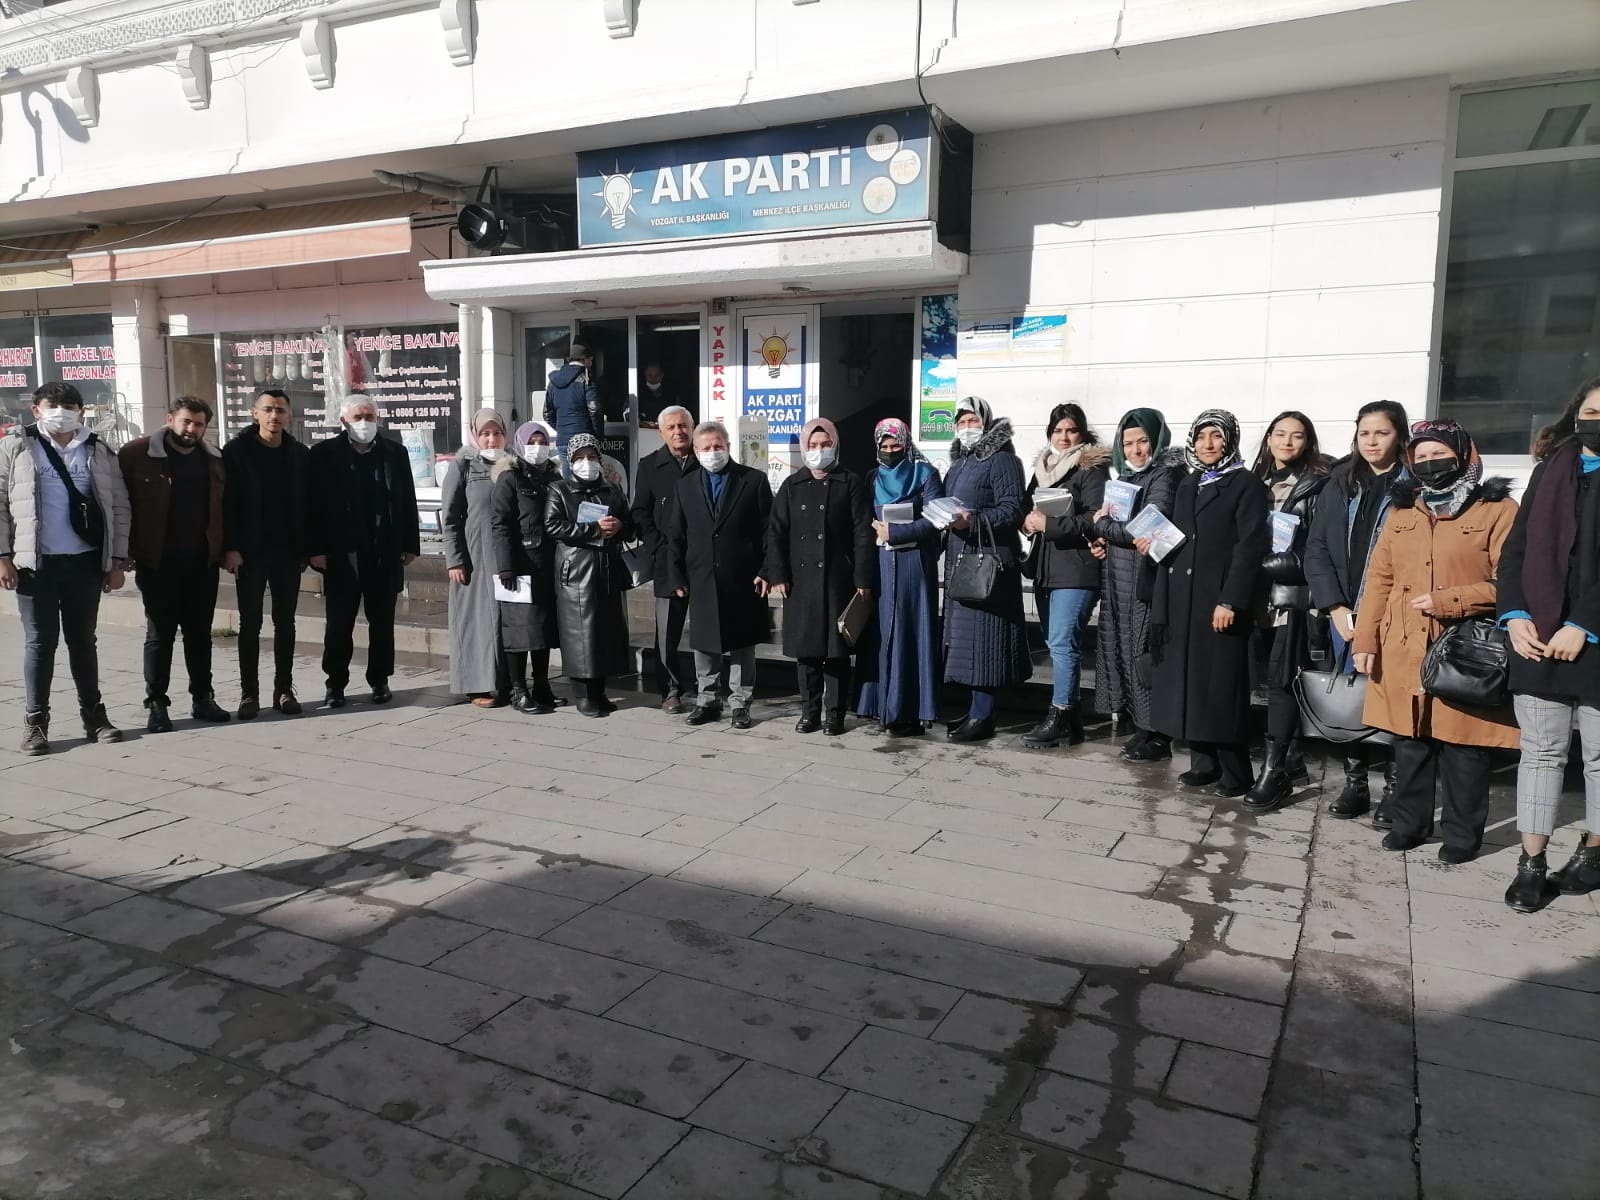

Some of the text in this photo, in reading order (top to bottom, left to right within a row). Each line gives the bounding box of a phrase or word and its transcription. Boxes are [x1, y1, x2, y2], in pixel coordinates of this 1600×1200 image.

[651, 163, 709, 204] AK
[752, 207, 783, 217] MERKEZ
[802, 200, 850, 213] BAŞKANLIĞI
[650, 216, 677, 226] YOZGAT
[686, 210, 729, 223] BAŞKANLIĞI
[229, 339, 273, 357] YENİCE
[354, 334, 402, 352] YENİCE
[54, 344, 99, 362] BİTKİSEL
[712, 326, 725, 400] YAPRAK
[747, 395, 765, 406] AK
